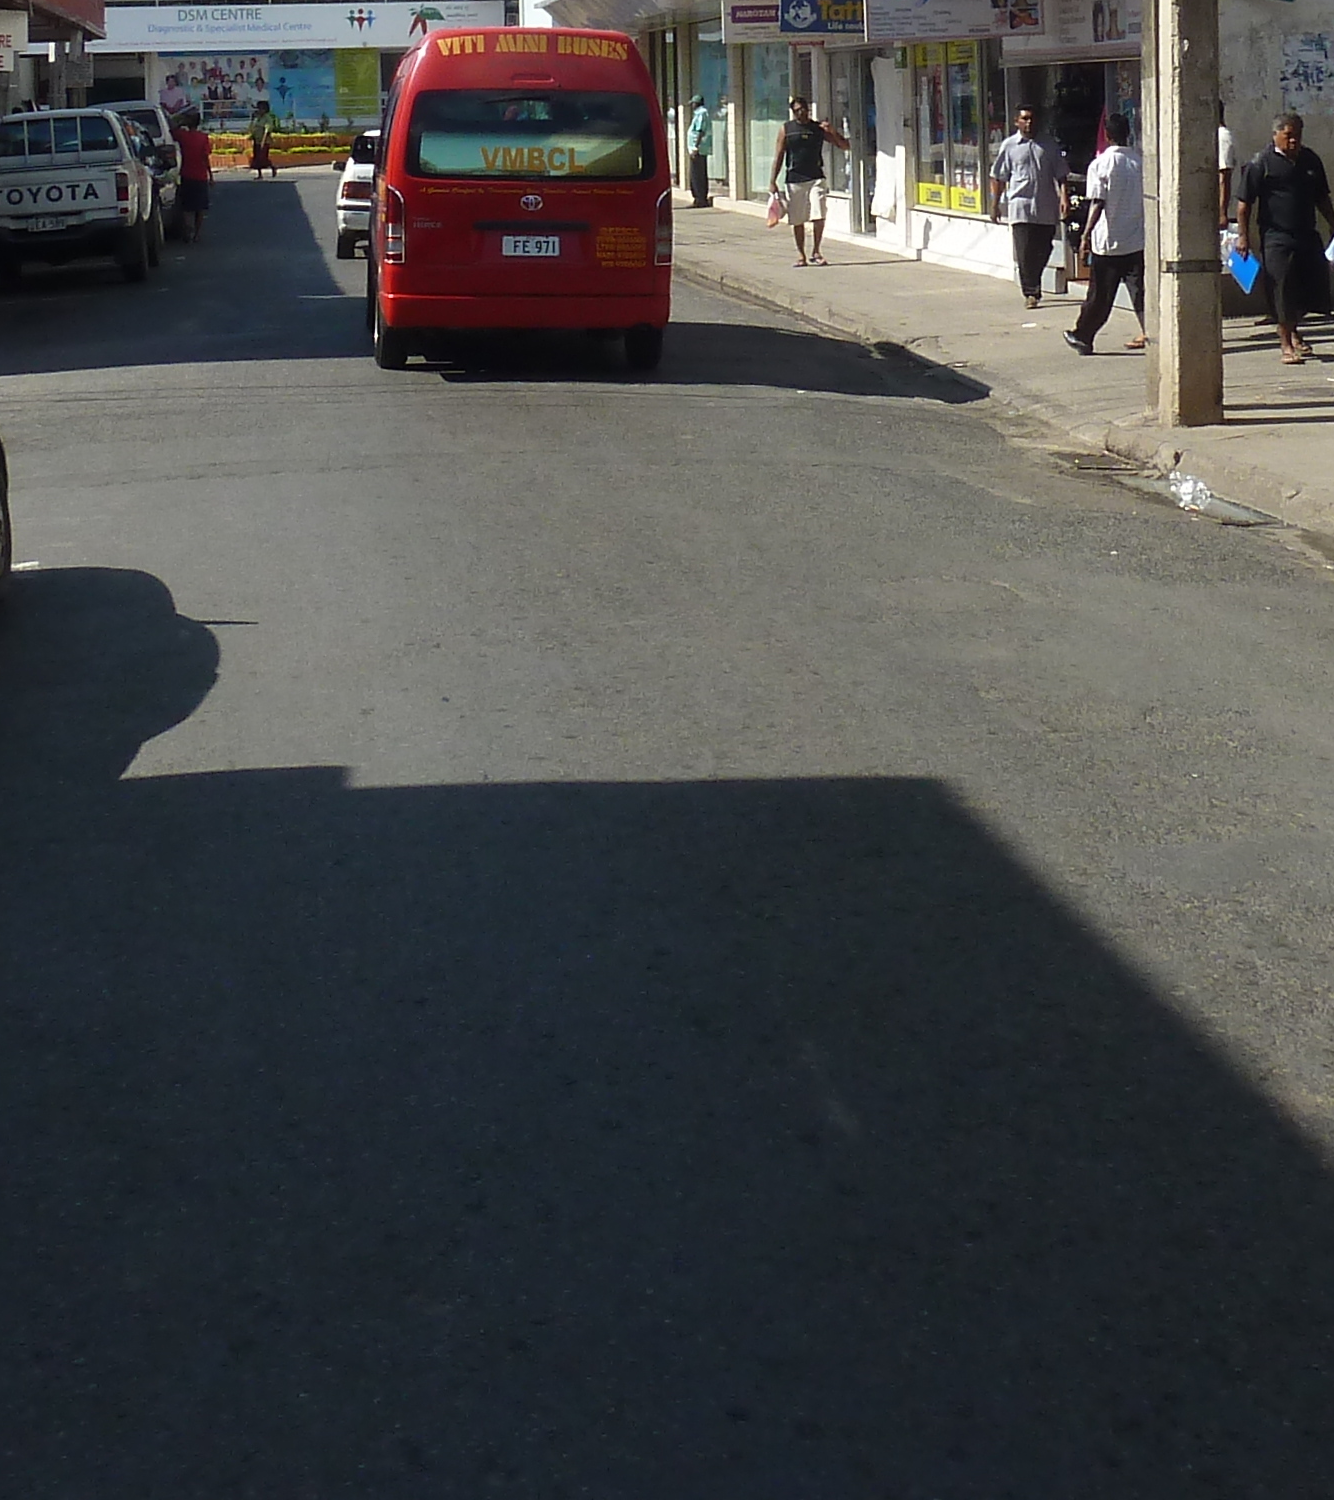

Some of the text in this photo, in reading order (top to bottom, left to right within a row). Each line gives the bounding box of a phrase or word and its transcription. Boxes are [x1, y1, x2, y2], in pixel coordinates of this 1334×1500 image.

[178, 8, 262, 21] DSM CENTRE
[437, 34, 629, 61] VITI MINI BUSES
[480, 146, 585, 173] VMBCL
[513, 240, 556, 255] FE 971
